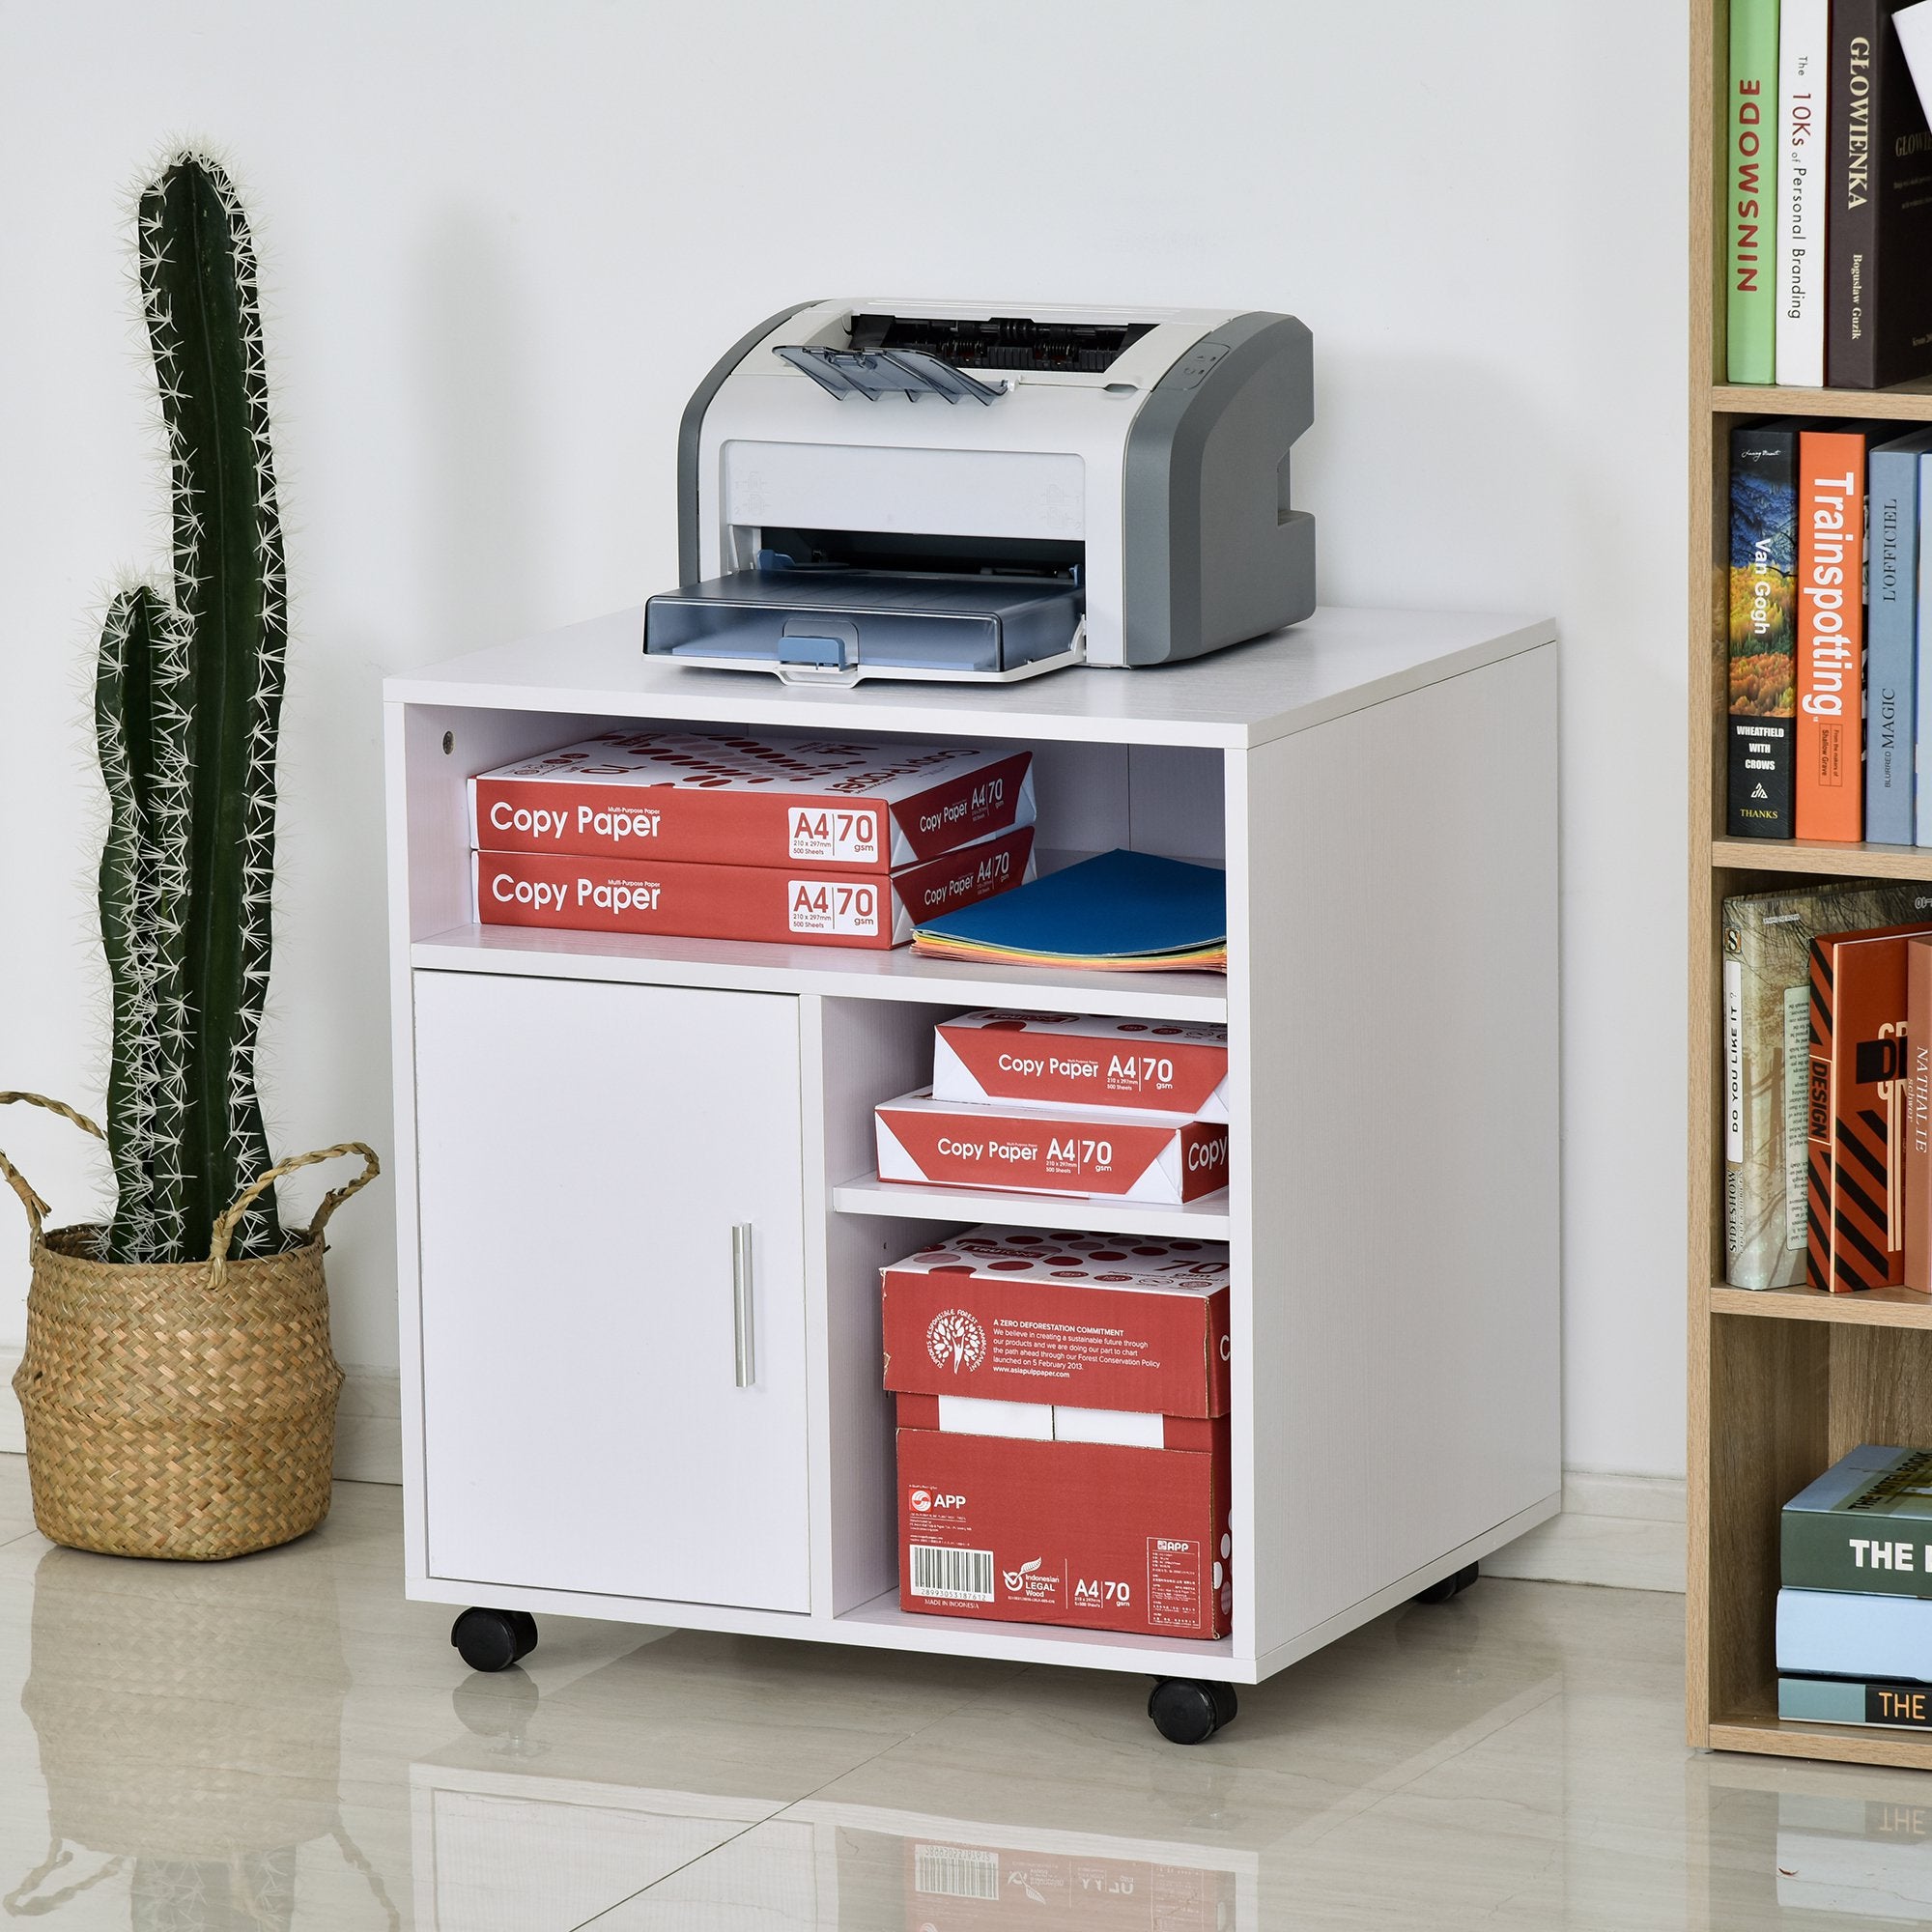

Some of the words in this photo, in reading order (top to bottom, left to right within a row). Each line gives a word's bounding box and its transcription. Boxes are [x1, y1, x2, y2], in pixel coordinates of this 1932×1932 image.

[1798, 56, 1808, 77] The
[1791, 92, 1811, 146] 10Ks
[1847, 36, 1870, 211] GŁOWIENKA
[1791, 152, 1800, 163] of
[1736, 78, 1761, 292] NINSMODE
[1791, 168, 1806, 241] Personal
[1787, 249, 1805, 320] Branding
[1850, 307, 1862, 341] Guzik
[1755, 538, 1771, 575] Van
[1883, 498, 1897, 603] L'OFFICIEL
[1750, 581, 1771, 634] Gogh
[1802, 471, 1855, 717] Trainspotting
[1736, 725, 1785, 738] WHEATFIELD
[1882, 687, 1896, 749] MAGIC
[1748, 743, 1772, 753] WITH
[1744, 759, 1776, 771] CROWS
[1884, 751, 1892, 789] BLURRED
[971, 784, 986, 810] A4
[988, 778, 1004, 804] 70
[490, 802, 567, 838] Copy
[577, 805, 661, 841] Paper
[794, 812, 829, 840] A4
[838, 814, 874, 842] 70
[920, 811, 942, 833] Copy
[943, 802, 968, 823] Paper
[1740, 809, 1778, 820] THANKS
[854, 844, 874, 852] gsm
[977, 857, 992, 883] A4
[994, 852, 1009, 877] 70
[492, 874, 568, 911] Copy
[577, 879, 661, 914] Paper
[794, 885, 829, 913] A4
[838, 887, 874, 917] 70
[924, 886, 948, 906] Copy
[949, 875, 974, 896] Paper
[854, 917, 874, 926] gsm
[1730, 1006, 1737, 1023] IT
[998, 1053, 1044, 1077] Copy
[1049, 1057, 1099, 1079] Paper
[1107, 1055, 1136, 1079] A4
[1143, 1058, 1173, 1082] 70
[1811, 1062, 1828, 1140] DESIGN
[1916, 1046, 1929, 1154] NATHALIE
[1732, 1112, 1739, 1133] DO
[937, 1137, 982, 1160] Copy
[988, 1141, 1038, 1163] Paper
[1046, 1137, 1076, 1161] A4
[1082, 1140, 1112, 1165] 70
[1188, 1136, 1228, 1172] Copy
[1727, 1170, 1738, 1253] SIDESHOW
[1153, 1259, 1230, 1274] 70
[1005, 1329, 1027, 1338] believe
[1036, 1332, 1061, 1342] creating
[1068, 1335, 1103, 1345] sustainable
[1104, 1338, 1122, 1346] future
[1123, 1339, 1148, 1349] through
[1020, 1321, 1076, 1333] DEFORESTATION
[1076, 1326, 1124, 1337] COMMITMENT
[993, 1356, 1022, 1365] launched
[1038, 1360, 1066, 1369] February
[1005, 1339, 1032, 1349] products
[1033, 1340, 1046, 1349] and
[1069, 1344, 1087, 1353] doing
[1100, 1347, 1113, 1356] part
[1122, 1349, 1138, 1357] chart
[1005, 1348, 1019, 1357] path
[1020, 1349, 1039, 1357] ahead
[1040, 1351, 1065, 1360] through
[1078, 1354, 1098, 1363] Forest
[1099, 1356, 1140, 1366] Conservation
[1141, 1359, 1160, 1368] Policy
[993, 1365, 1070, 1378] www.asiapulppaper.com
[933, 1494, 966, 1510] APP
[1167, 1542, 1189, 1552] APP
[1849, 1538, 1915, 1573] THE
[1025, 1574, 1060, 1583] Indonesian
[1025, 1582, 1055, 1592] LEGAL
[1074, 1578, 1099, 1598] A4
[1104, 1582, 1130, 1602] 70
[924, 1598, 941, 1606] MADE
[949, 1601, 980, 1610] INDONESIA
[1877, 1690, 1927, 1722] THE
